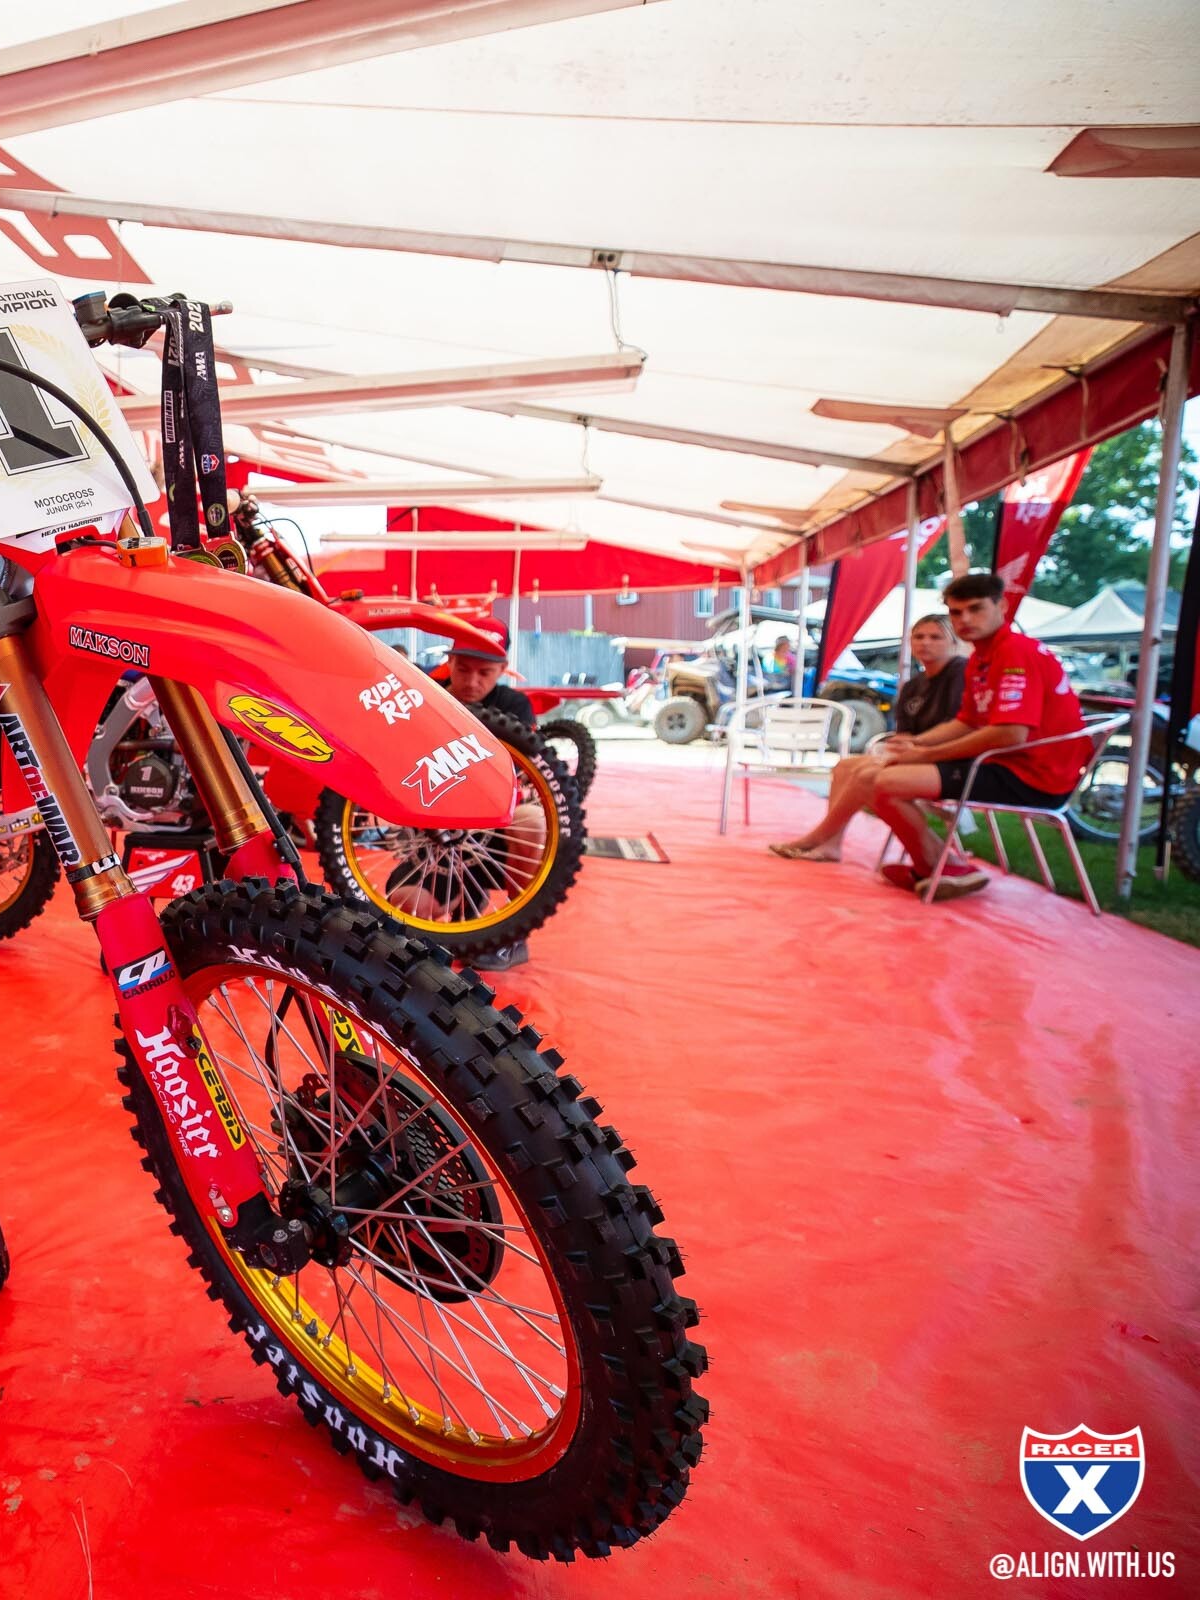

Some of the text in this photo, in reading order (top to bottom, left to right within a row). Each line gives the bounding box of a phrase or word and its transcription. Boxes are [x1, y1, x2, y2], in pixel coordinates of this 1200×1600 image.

[34, 487, 95, 509] MOTOCROSS
[45, 503, 75, 516] JUNIOR
[41, 516, 103, 538] HEATH HARRISON
[70, 626, 149, 667] MAKSON
[358, 673, 403, 711] RIDE
[377, 688, 425, 726] RED
[171, 874, 196, 892] 43
[122, 970, 177, 1000] CARRILLO
[135, 1025, 219, 1159] Hoosier
[150, 1071, 193, 1157] RACING TIRE
